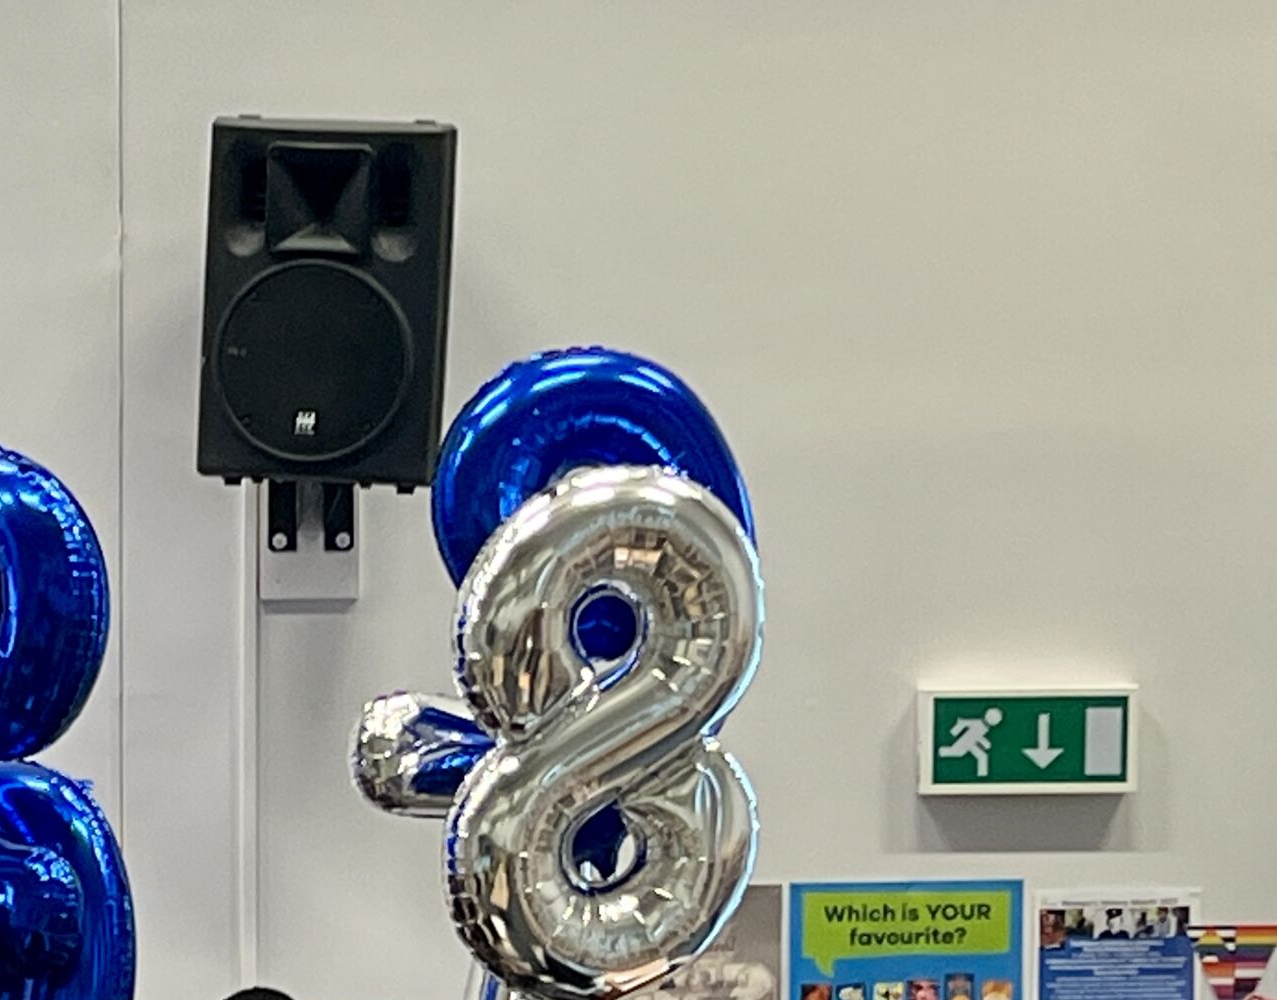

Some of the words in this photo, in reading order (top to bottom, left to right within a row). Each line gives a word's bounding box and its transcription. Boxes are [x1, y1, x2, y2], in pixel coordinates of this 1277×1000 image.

[824, 903, 896, 922] Which
[901, 903, 920, 921] is
[926, 903, 991, 921] YOUR
[849, 926, 967, 946] favourite?
